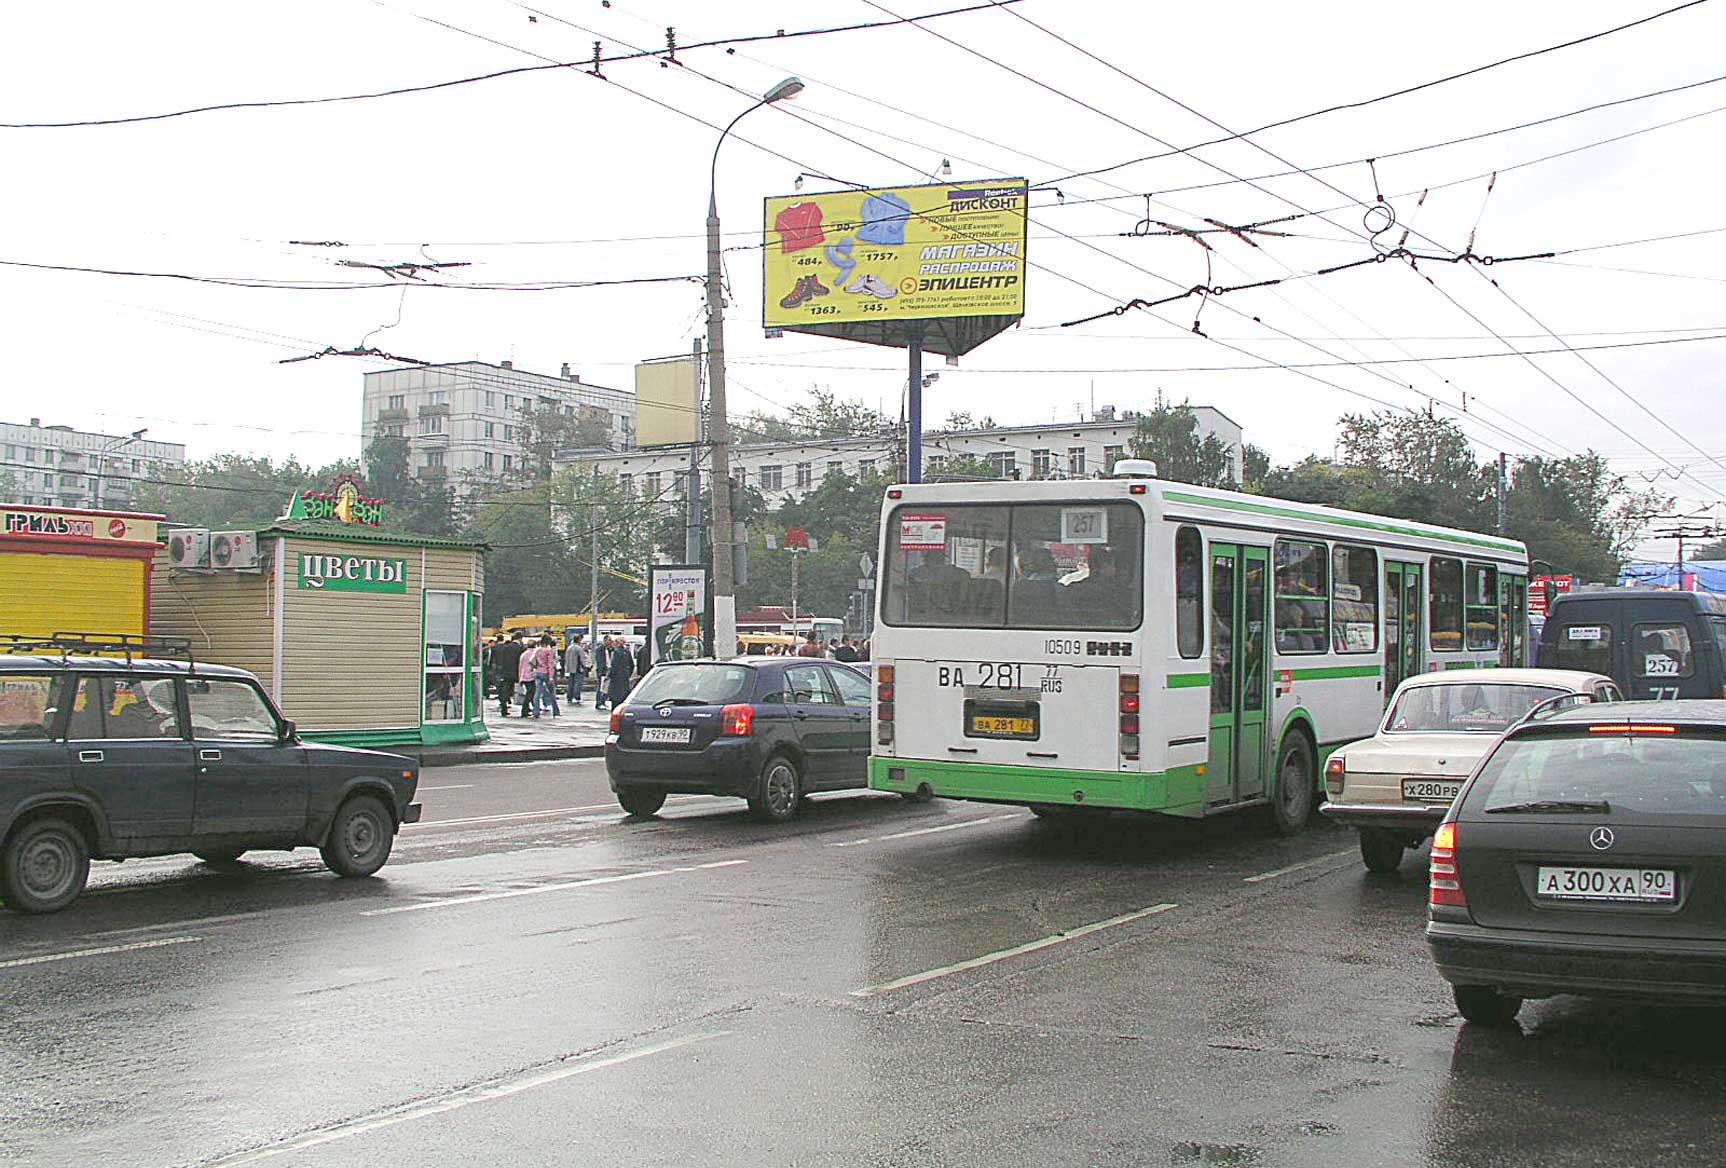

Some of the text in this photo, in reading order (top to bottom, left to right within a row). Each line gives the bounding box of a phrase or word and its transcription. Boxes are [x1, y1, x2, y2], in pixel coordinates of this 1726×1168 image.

[950, 198, 1017, 212] ДИСКОНТ
[950, 232, 998, 240] ДОСТУПНЫЕ
[920, 242, 1018, 260] МАГАЗИН
[920, 260, 1017, 275] РАСПРОДАЖ
[919, 276, 1018, 291] ЭПИЦЕНТР
[5, 513, 69, 533] ГРИЛЬ
[1073, 515, 1094, 533] 257
[1044, 640, 1080, 655] 10509
[939, 663, 1021, 690] ВА 281
[1045, 665, 1058, 677] 77
[1041, 680, 1062, 693] RUS
[994, 719, 1013, 730] 281
[1642, 872, 1666, 888] 90
